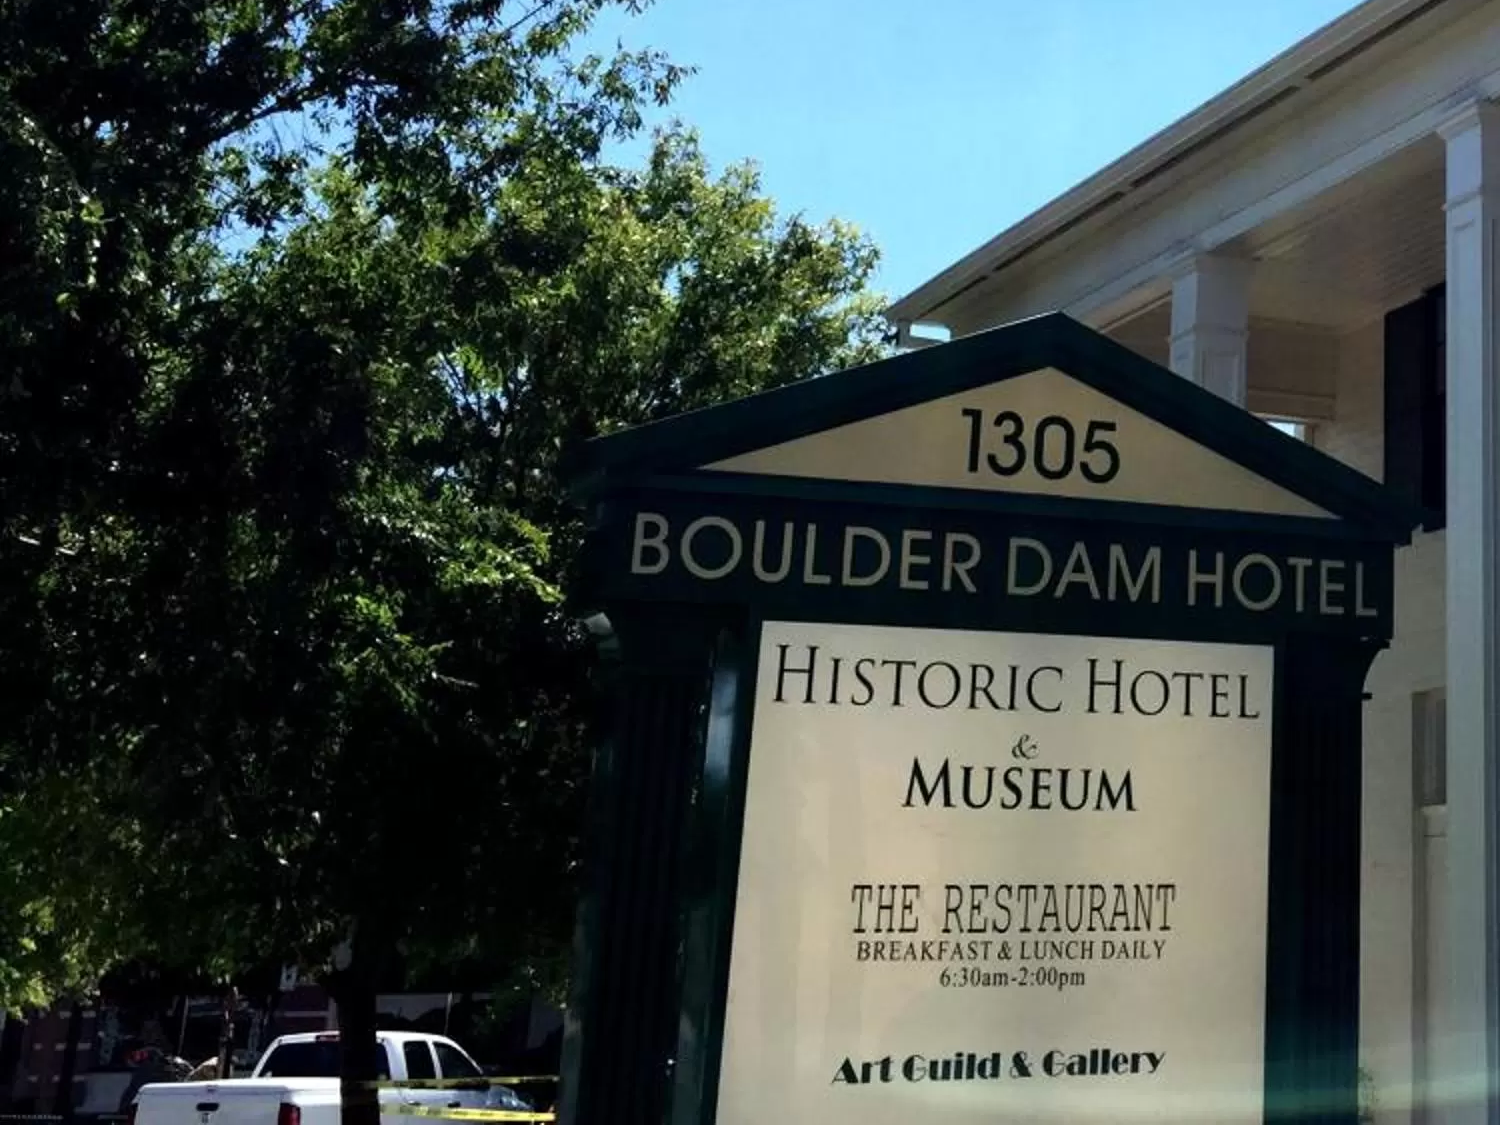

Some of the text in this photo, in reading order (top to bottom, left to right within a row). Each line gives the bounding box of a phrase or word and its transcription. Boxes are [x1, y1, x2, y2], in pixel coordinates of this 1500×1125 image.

[961, 407, 1121, 485] 1305
[631, 511, 1379, 619] BOULDER DAM HOTEL
[772, 644, 1261, 720] HISTORIC HOTEL
[1010, 733, 1038, 760] &
[901, 757, 1137, 812] MUSEUM
[851, 883, 1177, 935] THE RESTAURANT
[856, 939, 1167, 963] BREAKFAST & LUNCH DAILY
[939, 966, 1087, 992] 6:30am-2:00pm
[831, 1047, 1167, 1086] Art Guild & Gallery
